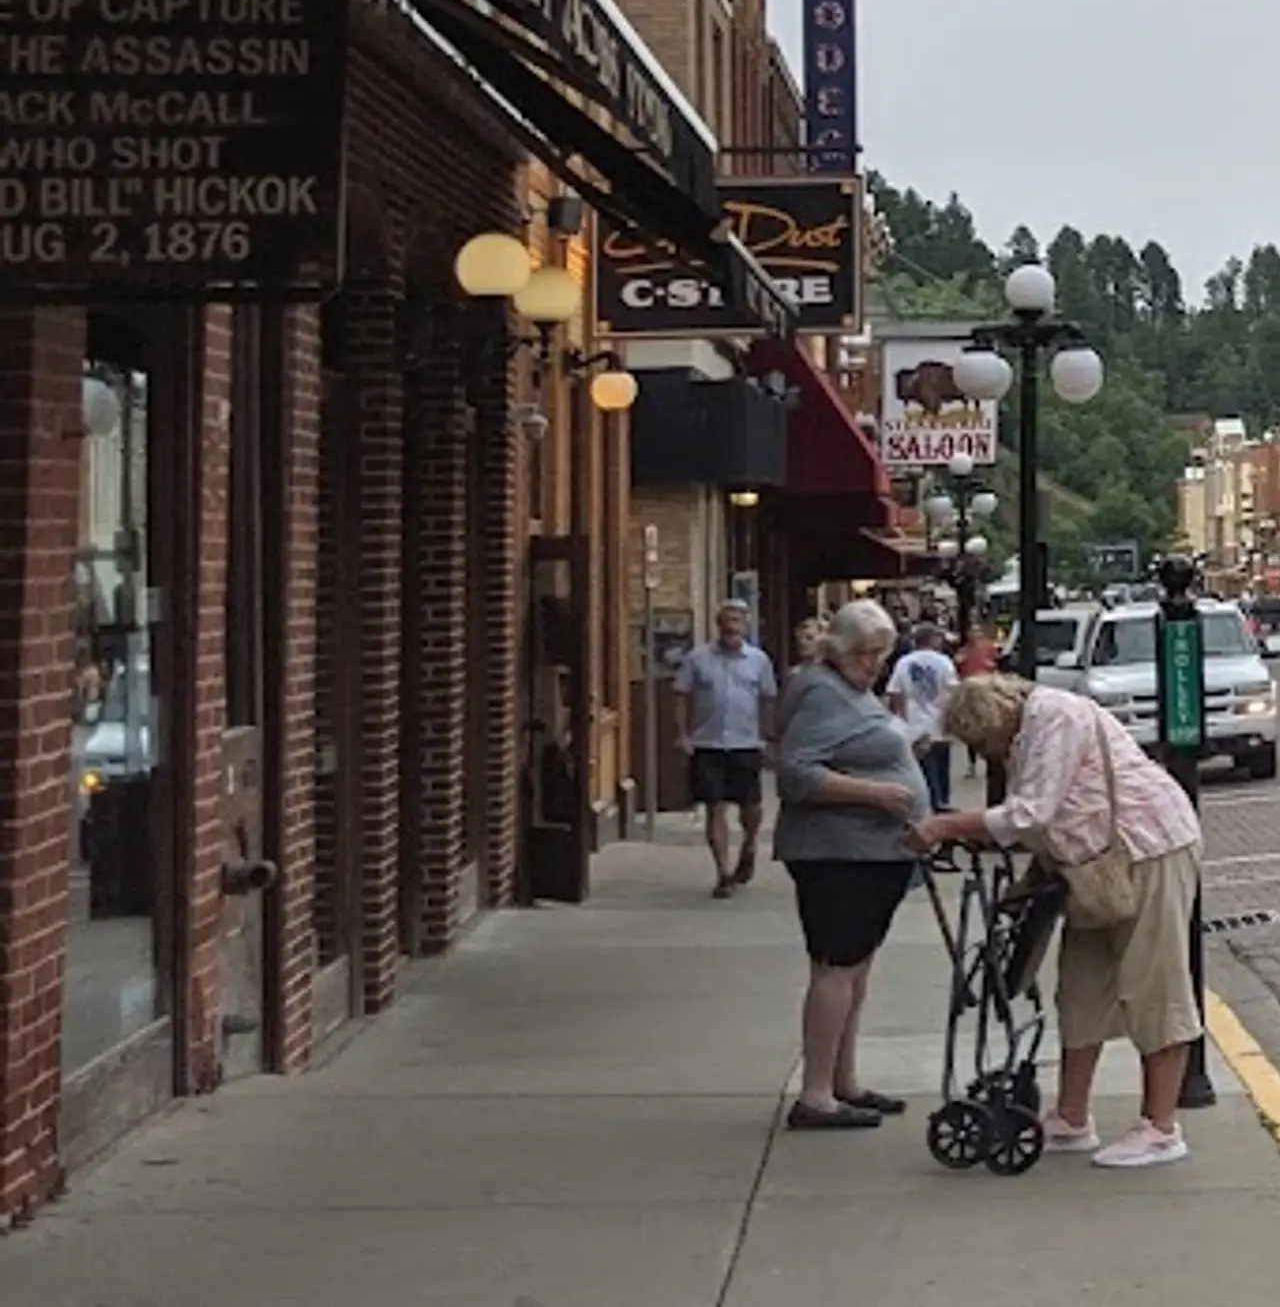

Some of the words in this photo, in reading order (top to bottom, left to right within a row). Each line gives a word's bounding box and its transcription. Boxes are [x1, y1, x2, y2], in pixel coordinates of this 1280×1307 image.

[82, 35, 309, 75] ASSASSIN
[89, 90, 267, 125] McCALL
[0, 135, 96, 169] WHO
[111, 136, 226, 169] SHOT
[153, 175, 317, 215] HICKOK
[90, 222, 130, 267] 2,
[144, 221, 250, 262] 1876
[888, 433, 991, 460] SALOON
